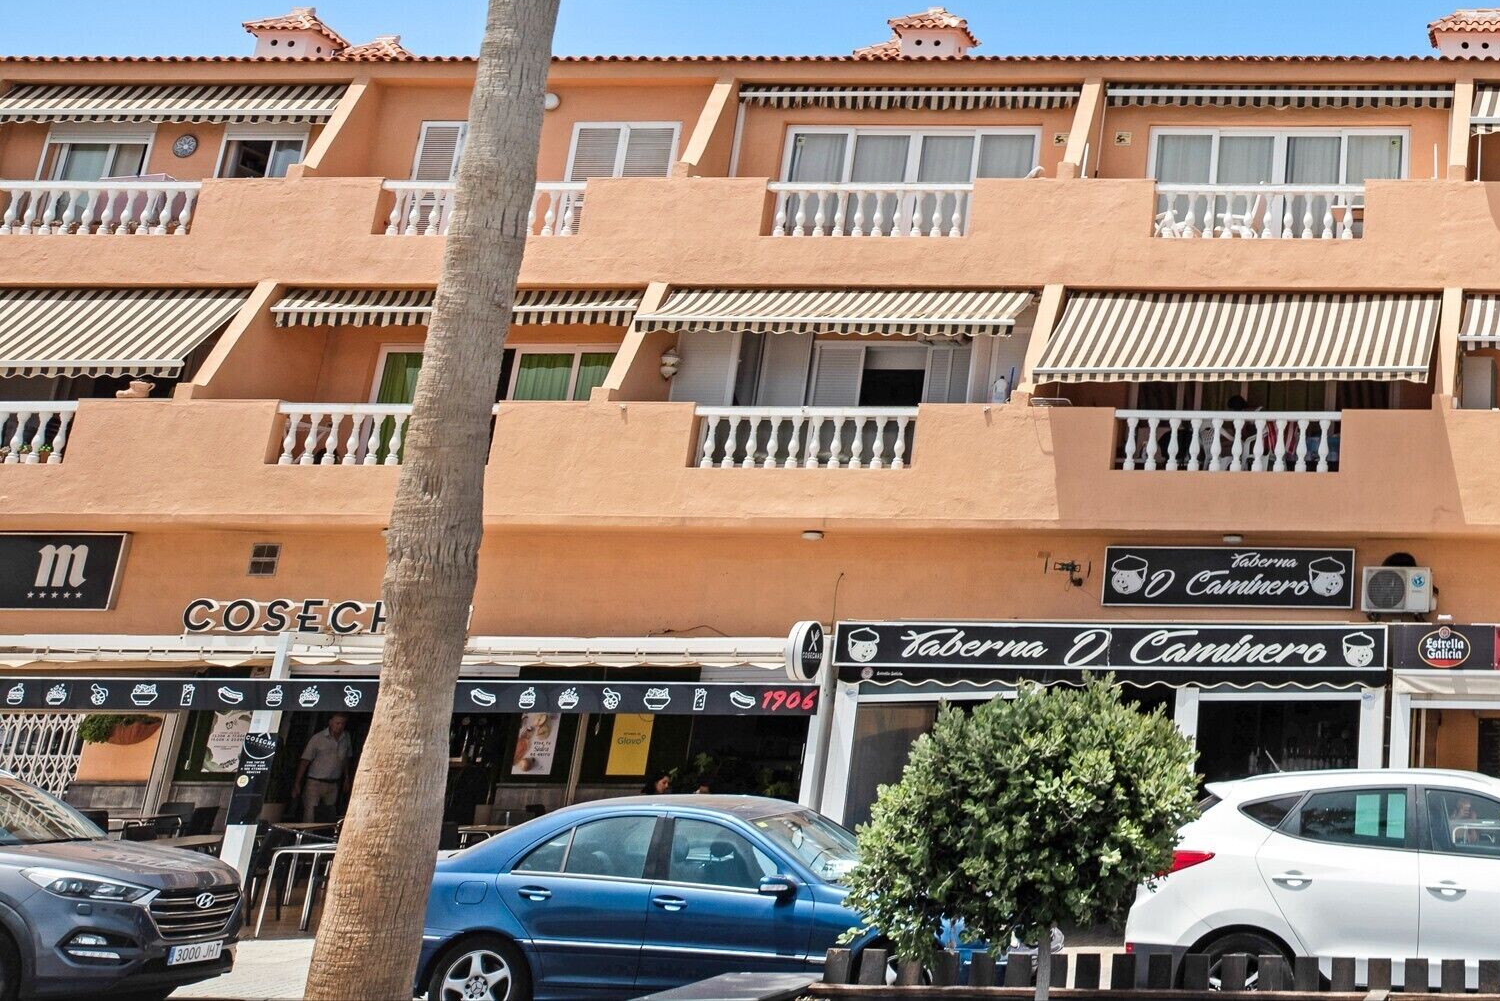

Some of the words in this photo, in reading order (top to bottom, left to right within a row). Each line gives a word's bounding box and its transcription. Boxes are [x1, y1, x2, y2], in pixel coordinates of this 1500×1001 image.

[1231, 552, 1299, 569] Taberna
[1185, 570, 1309, 596] Caminero
[901, 628, 1048, 659] Taberna
[1129, 630, 1327, 665] Caminero
[1425, 638, 1464, 649] Estrella
[1427, 648, 1462, 659] Galicia
[761, 689, 818, 711] 1906
[175, 946, 202, 962] 3000
[203, 943, 220, 958] JHT
